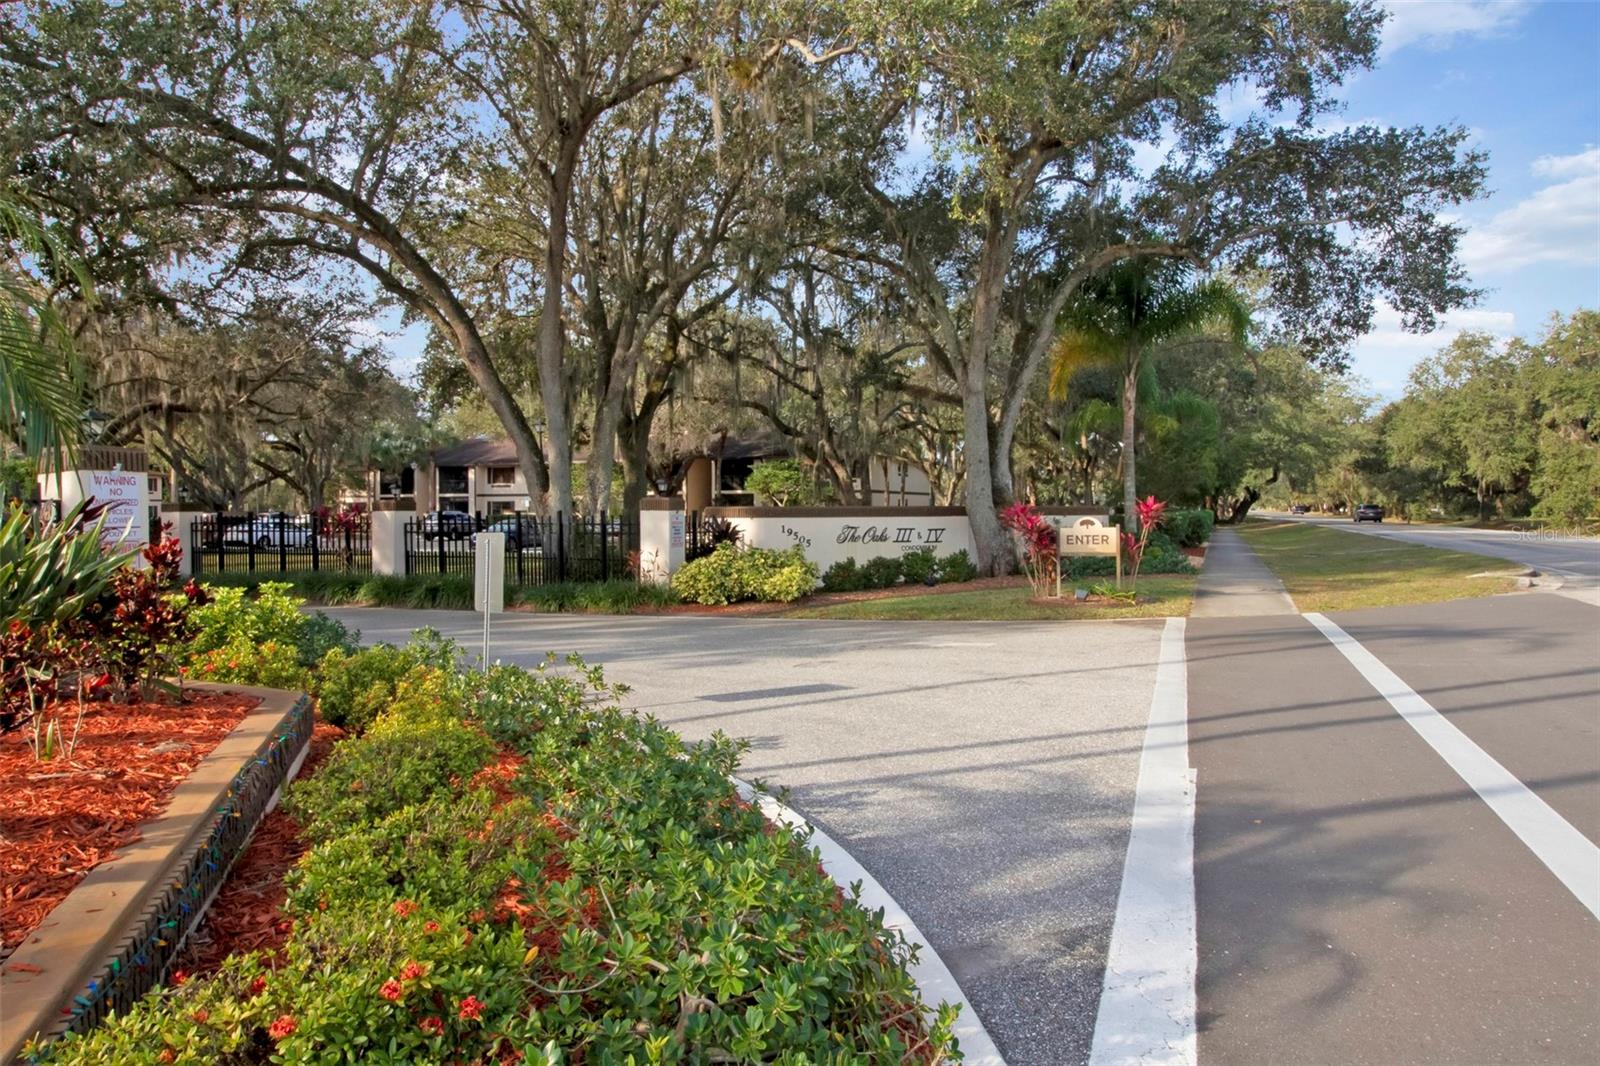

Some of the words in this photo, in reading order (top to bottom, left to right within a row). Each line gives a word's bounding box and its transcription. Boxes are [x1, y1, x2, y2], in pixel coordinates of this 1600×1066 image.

[95, 476, 136, 486] WARNING
[110, 488, 123, 496] NO
[781, 525, 812, 548] 19505
[836, 524, 861, 544] The
[862, 526, 890, 544] Oaks
[892, 528, 916, 543] III
[923, 528, 946, 543] IV
[1066, 534, 1110, 545] ENTER
